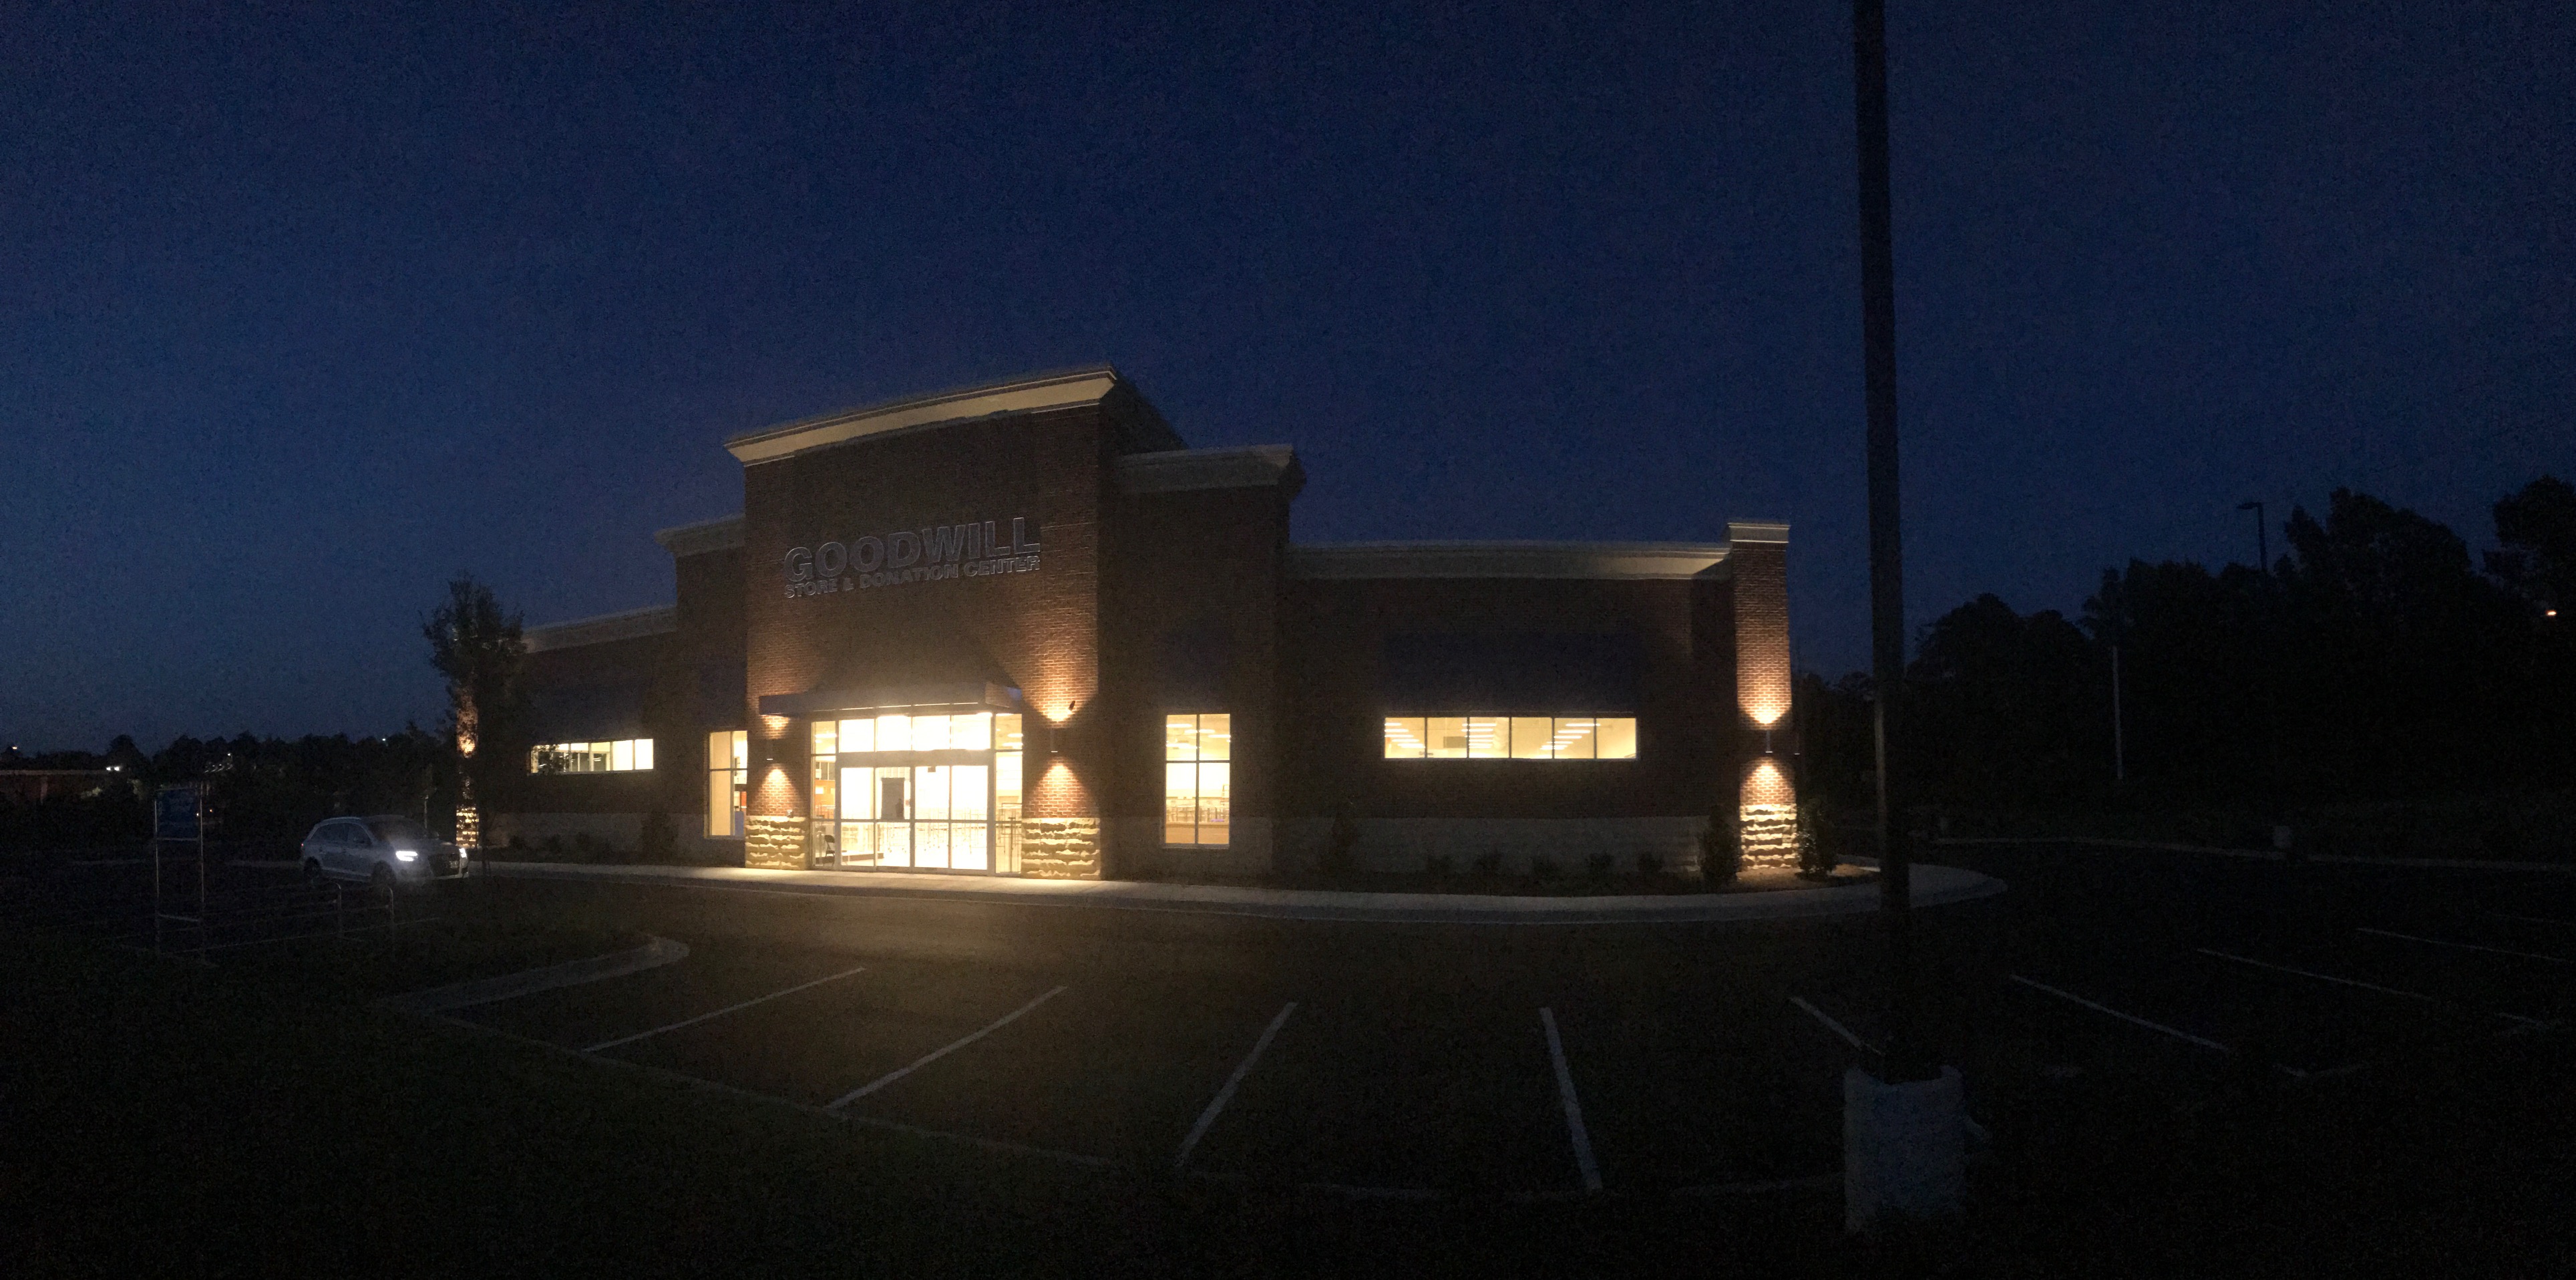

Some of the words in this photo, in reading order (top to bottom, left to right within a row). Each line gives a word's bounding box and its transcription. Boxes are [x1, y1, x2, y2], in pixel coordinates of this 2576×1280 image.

[783, 517, 1041, 582] GOODWILL
[784, 579, 838, 599] STORE
[843, 577, 854, 591] &
[860, 564, 958, 589] DONATION
[964, 555, 1041, 577] CENTER
